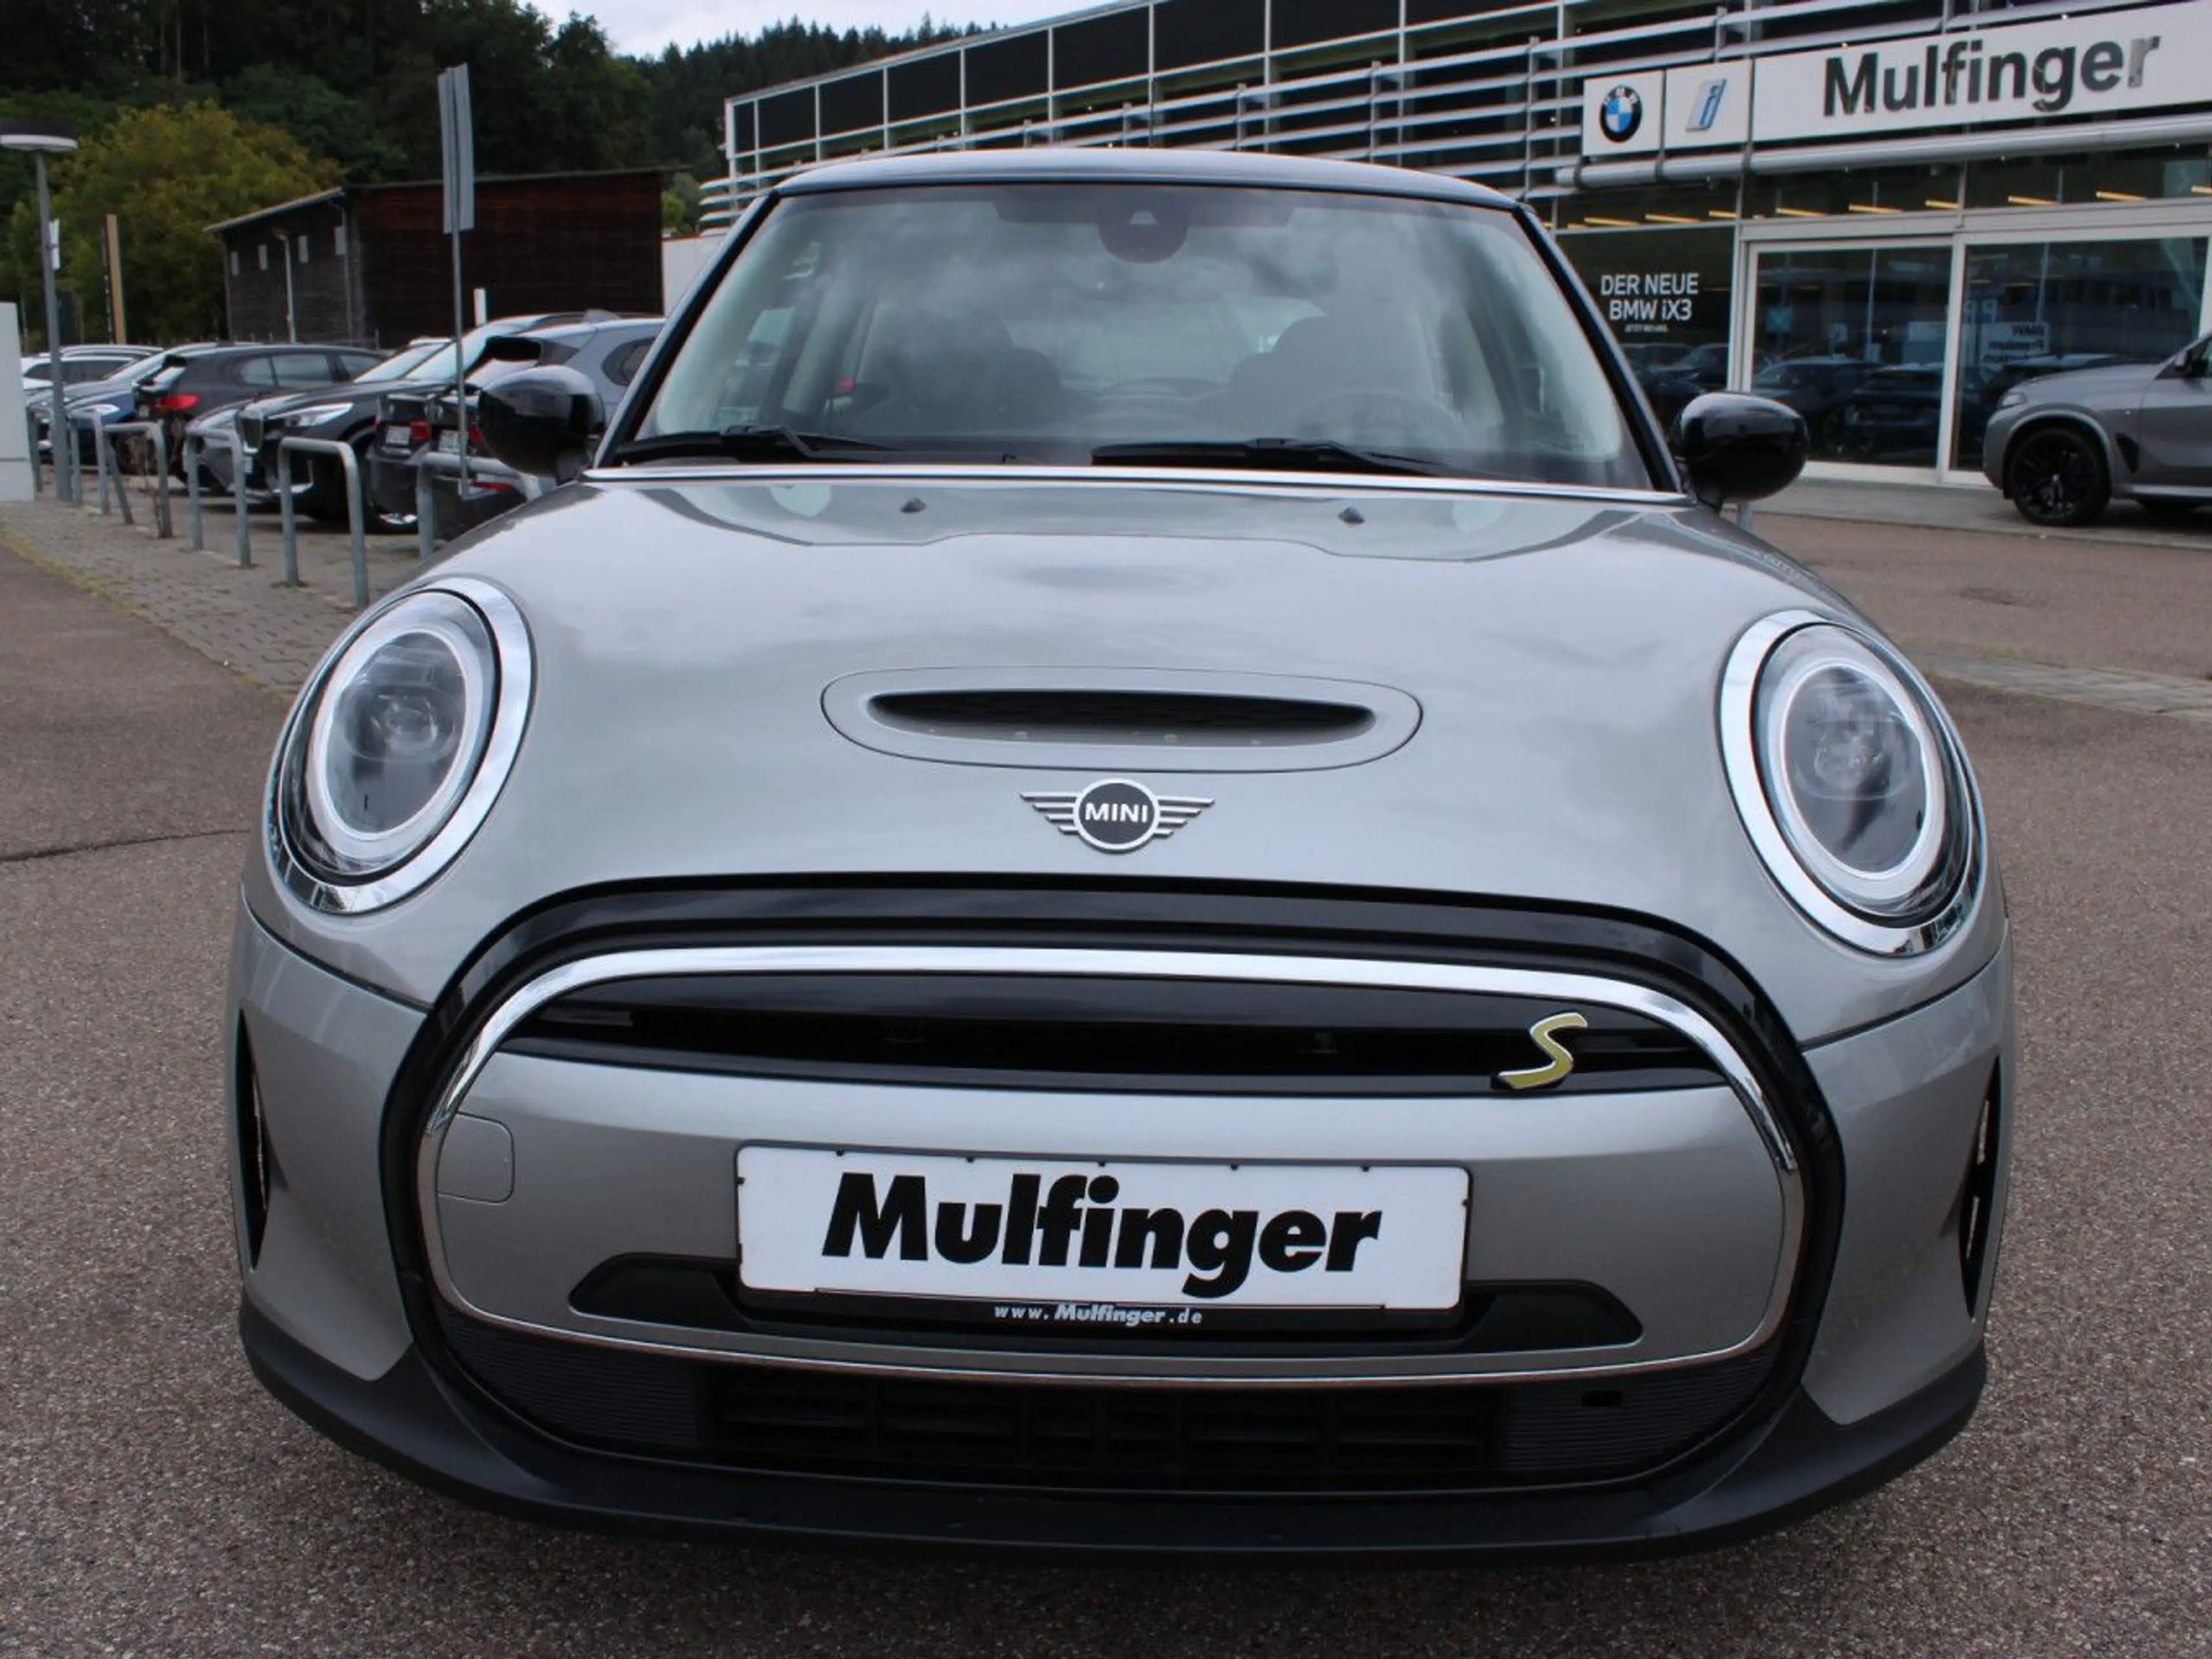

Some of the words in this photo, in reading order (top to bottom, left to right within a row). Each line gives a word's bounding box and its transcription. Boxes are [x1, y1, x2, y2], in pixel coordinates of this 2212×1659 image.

[1823, 35, 2161, 116] Mulfinger
[1600, 273, 1641, 296] DER
[1644, 272, 1699, 296] NEUE
[1609, 298, 1658, 321] BMW
[1661, 298, 1692, 321] iX3
[1084, 802, 1149, 823] MINI
[1498, 1012, 1588, 1090] S
[821, 1171, 1382, 1298] Mulfinger
